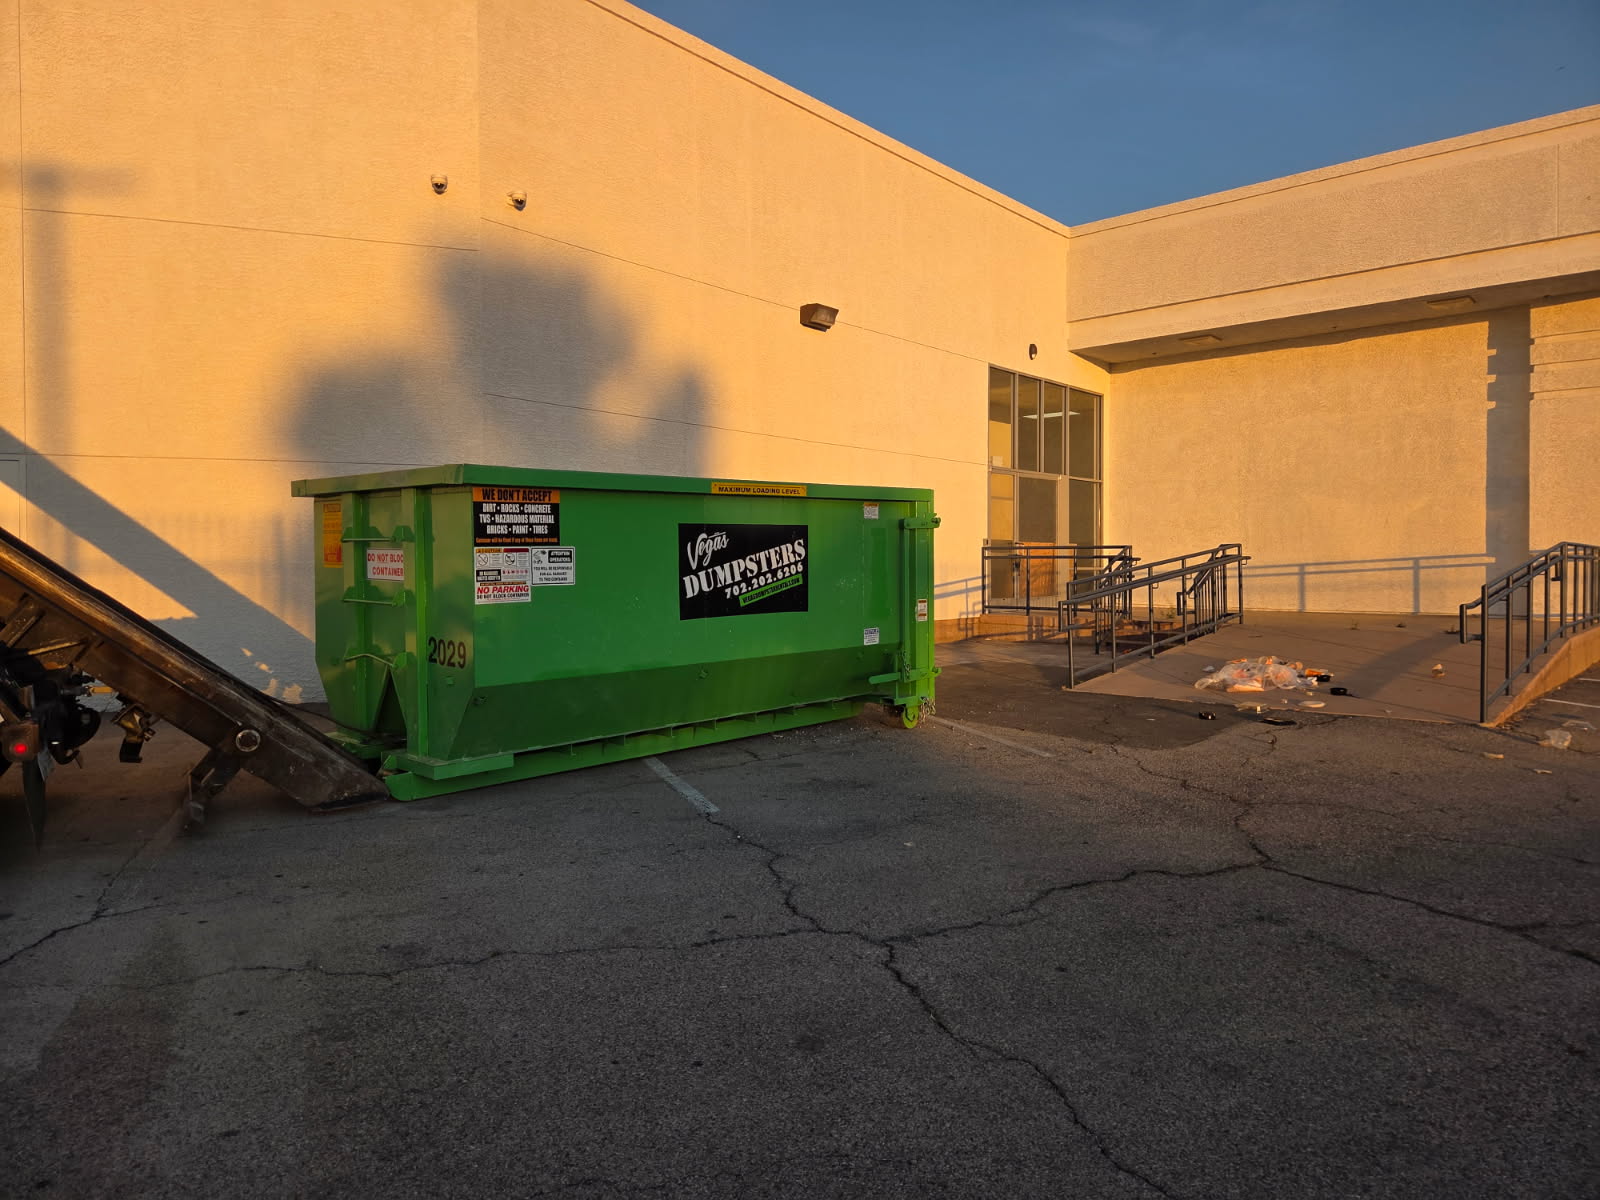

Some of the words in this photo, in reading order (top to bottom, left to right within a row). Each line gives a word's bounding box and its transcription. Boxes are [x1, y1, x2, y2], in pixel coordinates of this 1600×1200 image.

[482, 488, 496, 500] WE
[497, 489, 520, 501] DON'T
[522, 490, 552, 501] ACCEPT
[482, 503, 496, 512] DIRT
[500, 504, 520, 513] ROCKS
[524, 504, 551, 513] CONCRETE
[479, 514, 491, 523] TVS
[495, 514, 528, 524] HAZARDOUS
[529, 514, 555, 524] MATERIAL
[486, 525, 508, 534] BRICKS
[512, 525, 528, 534] PAINT
[533, 525, 548, 534] TIRES
[686, 532, 730, 570] Vegas
[368, 553, 376, 562] DO
[377, 553, 388, 562] NOT
[390, 554, 404, 563] BLOC
[372, 567, 404, 576] CONTAINER
[683, 538, 806, 598] DUMPSTERS
[725, 563, 804, 599] 702.202.6206
[477, 586, 490, 594] NO
[492, 585, 529, 594] PARKING
[428, 636, 466, 669] 2029
